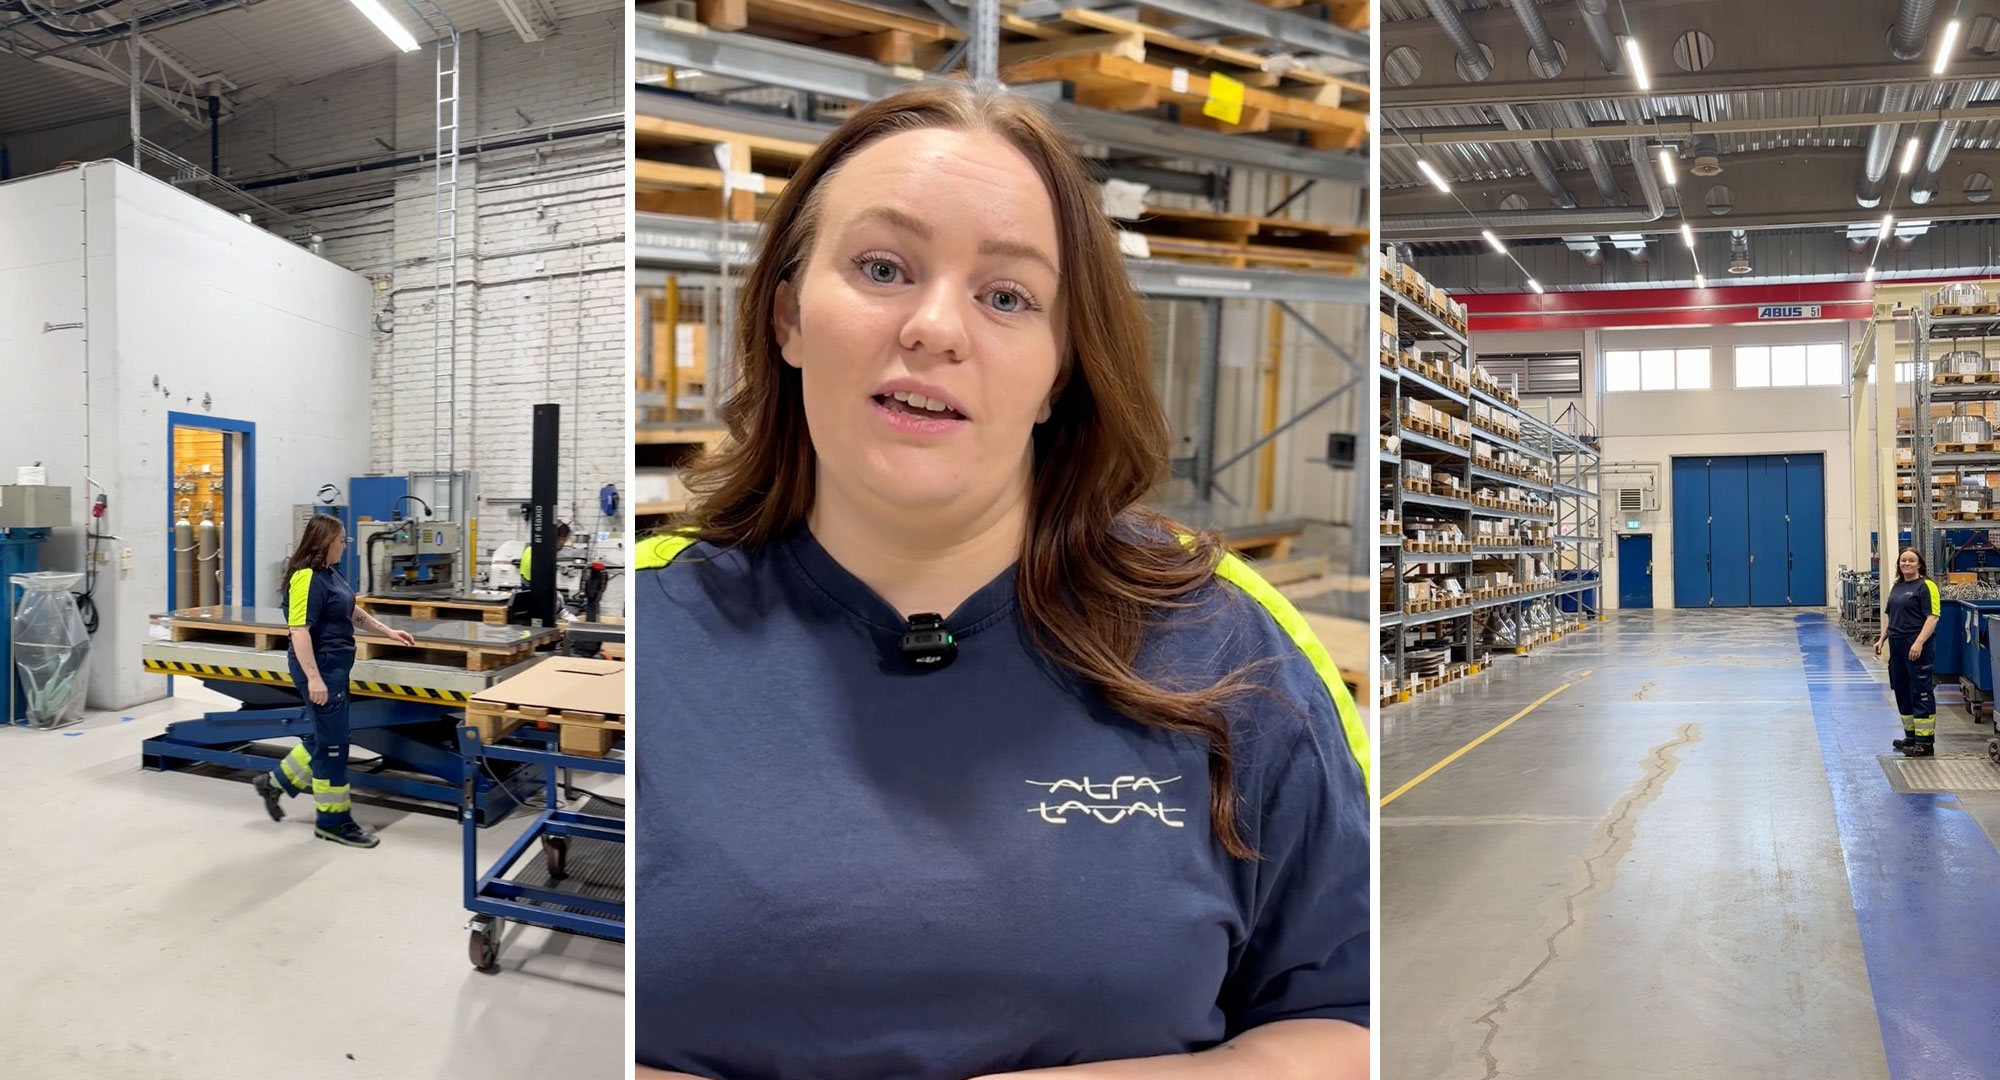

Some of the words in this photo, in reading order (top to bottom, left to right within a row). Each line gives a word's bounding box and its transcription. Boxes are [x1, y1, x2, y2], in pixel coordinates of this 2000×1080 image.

[1760, 306, 1802, 317] ABUS
[1048, 775, 1162, 800] ALFA
[1038, 800, 1184, 827] LAVAL
